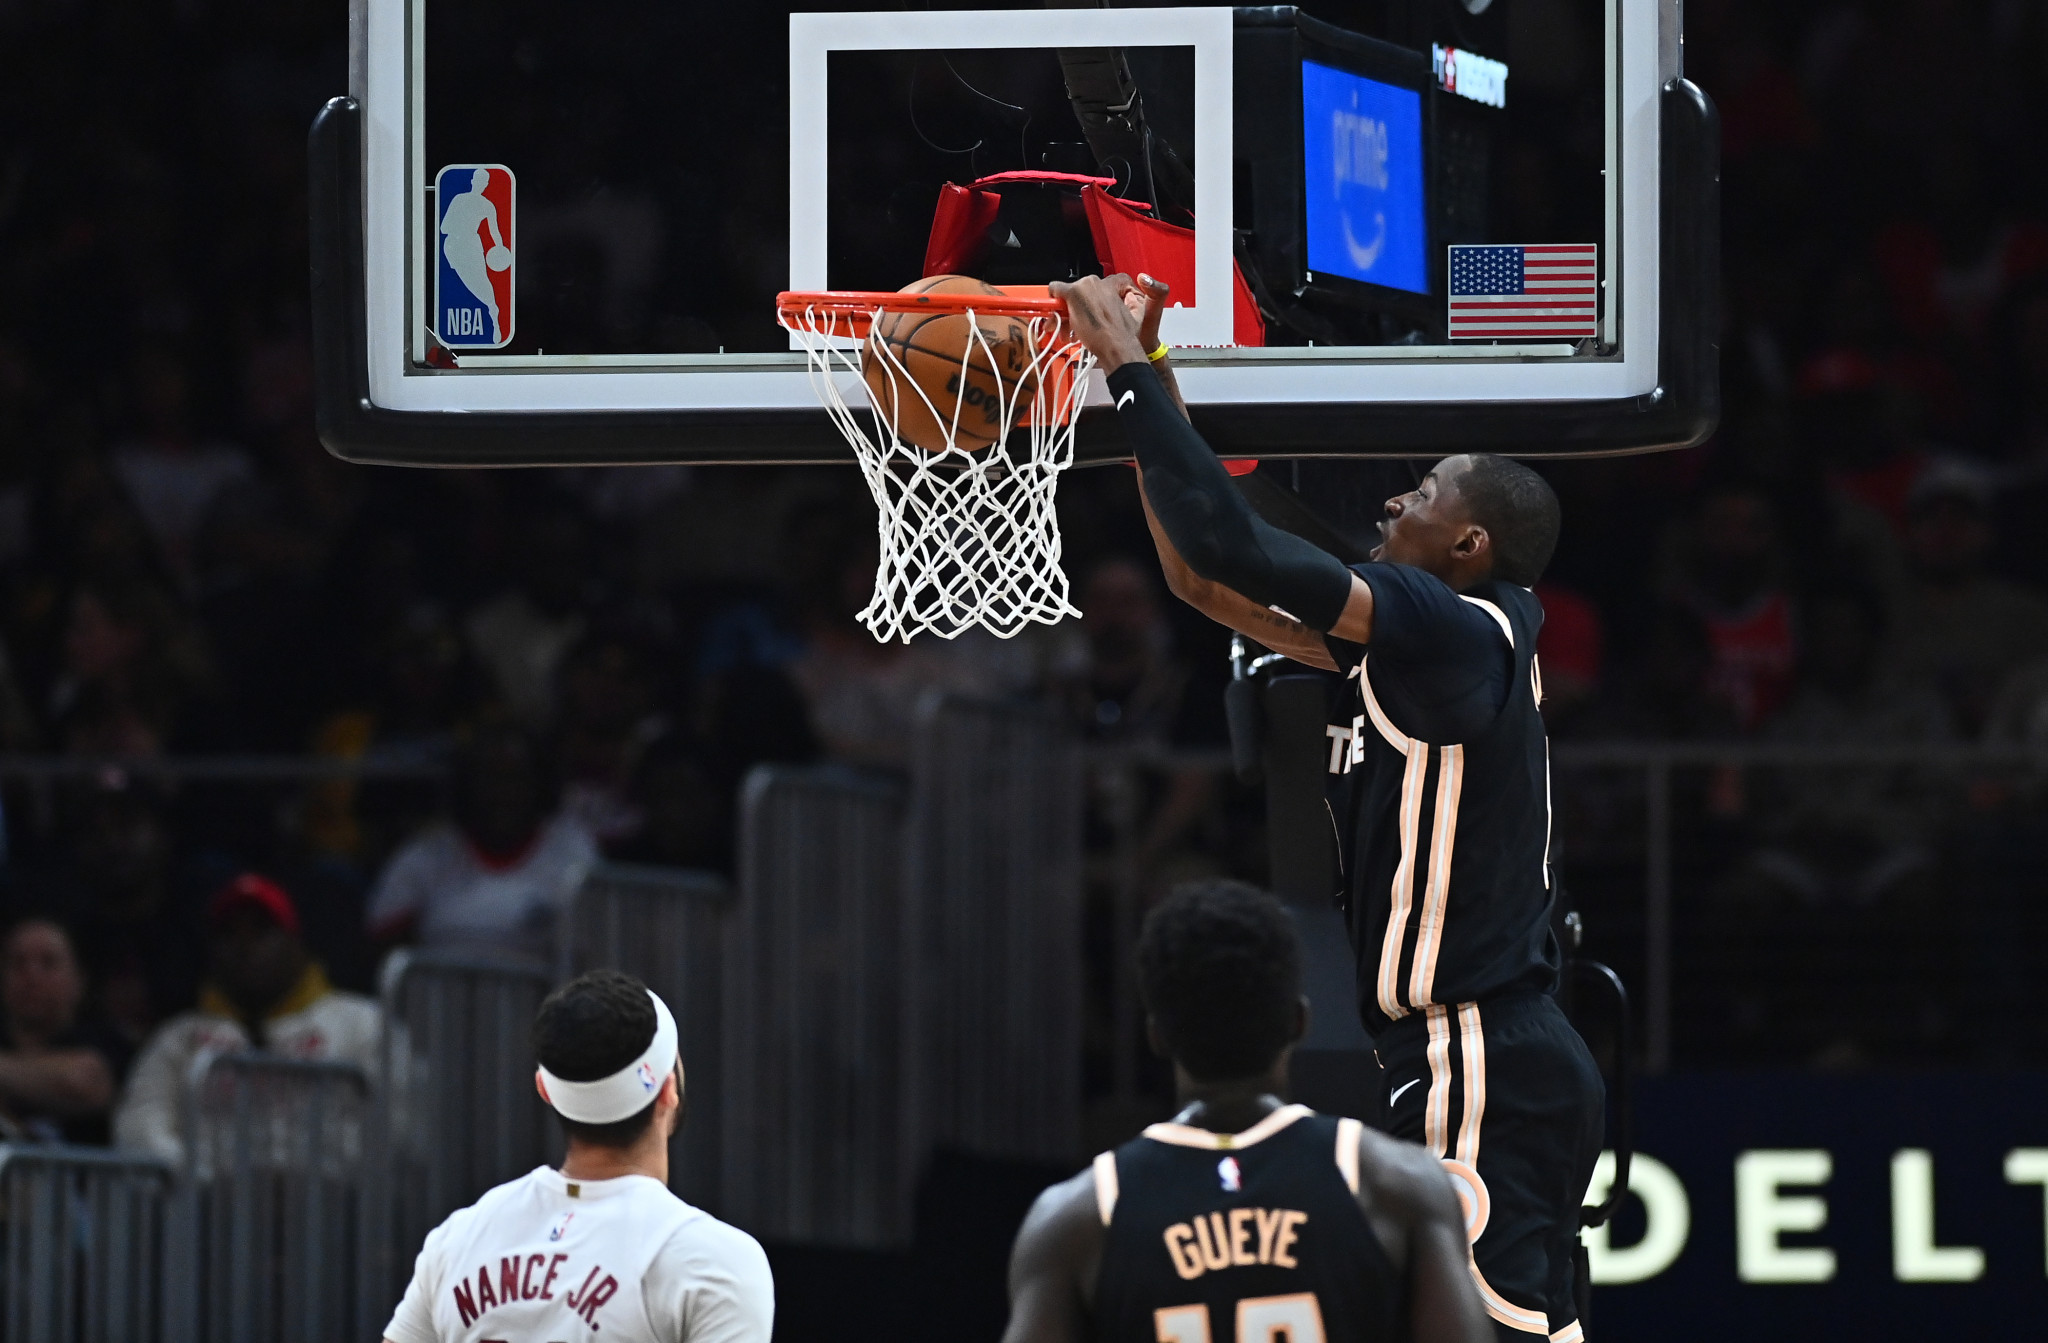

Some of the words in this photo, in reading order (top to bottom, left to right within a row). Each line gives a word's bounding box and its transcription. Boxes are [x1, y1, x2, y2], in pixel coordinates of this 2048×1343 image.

[447, 307, 485, 336] NBA
[1163, 1207, 1308, 1280] GUEYE
[453, 1253, 568, 1329] NANCE
[567, 1265, 619, 1332] JR.
